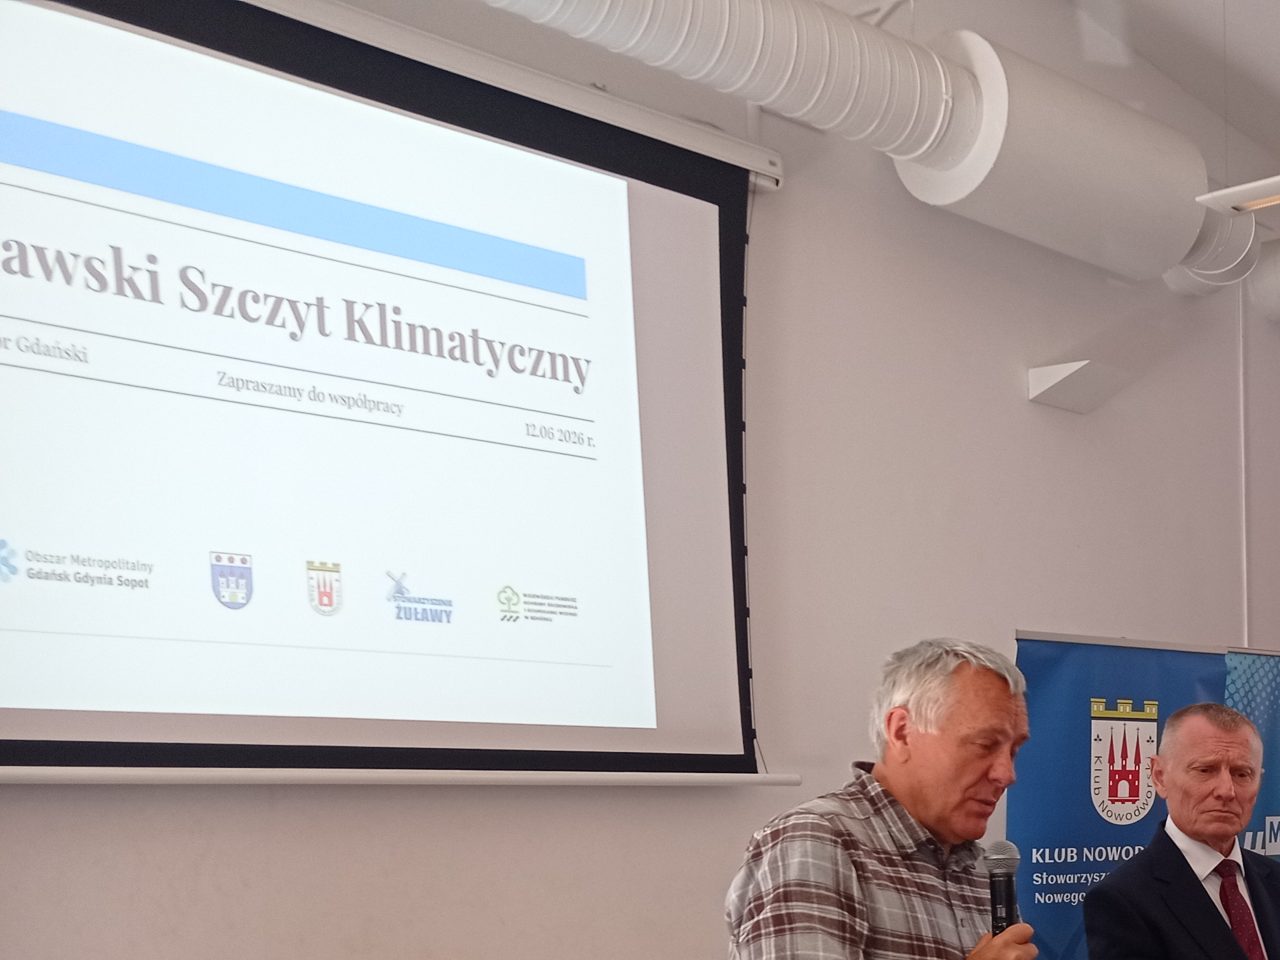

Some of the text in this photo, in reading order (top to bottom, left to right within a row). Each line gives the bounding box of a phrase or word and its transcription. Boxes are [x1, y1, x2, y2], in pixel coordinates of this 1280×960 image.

[1, 238, 592, 395] awski Szczyt Klimatyczny
[15, 336, 89, 364] Gdański
[216, 371, 404, 417] Zapraszamy do współpracy
[25, 550, 154, 575] Obszar Metropolitalny
[26, 568, 150, 589] Gdańsk Gdynia Sopot
[395, 604, 453, 623] ŻUŁAWY
[1094, 756, 1103, 796] Klub
[1031, 848, 1078, 864] KLUB
[1032, 871, 1111, 886] Stowarzysz
